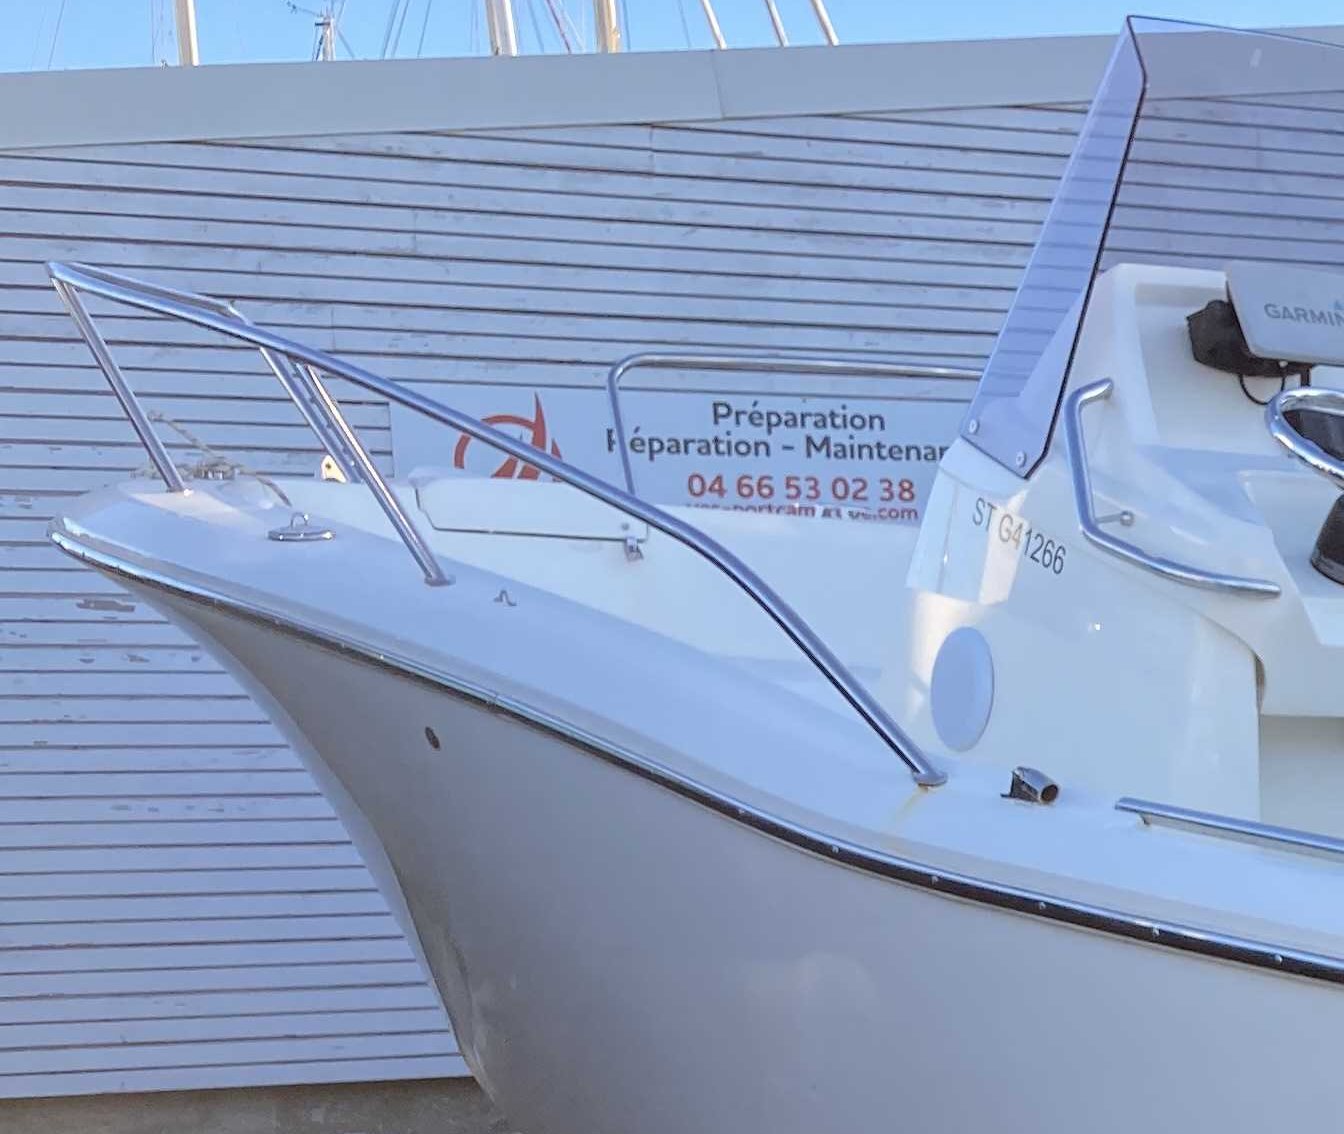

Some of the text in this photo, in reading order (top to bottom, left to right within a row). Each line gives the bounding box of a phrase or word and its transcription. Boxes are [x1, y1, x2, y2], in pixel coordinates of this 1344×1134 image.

[712, 400, 887, 435] Préparation
[687, 474, 916, 502] 04 66 53 02 38
[973, 497, 998, 532] ST
